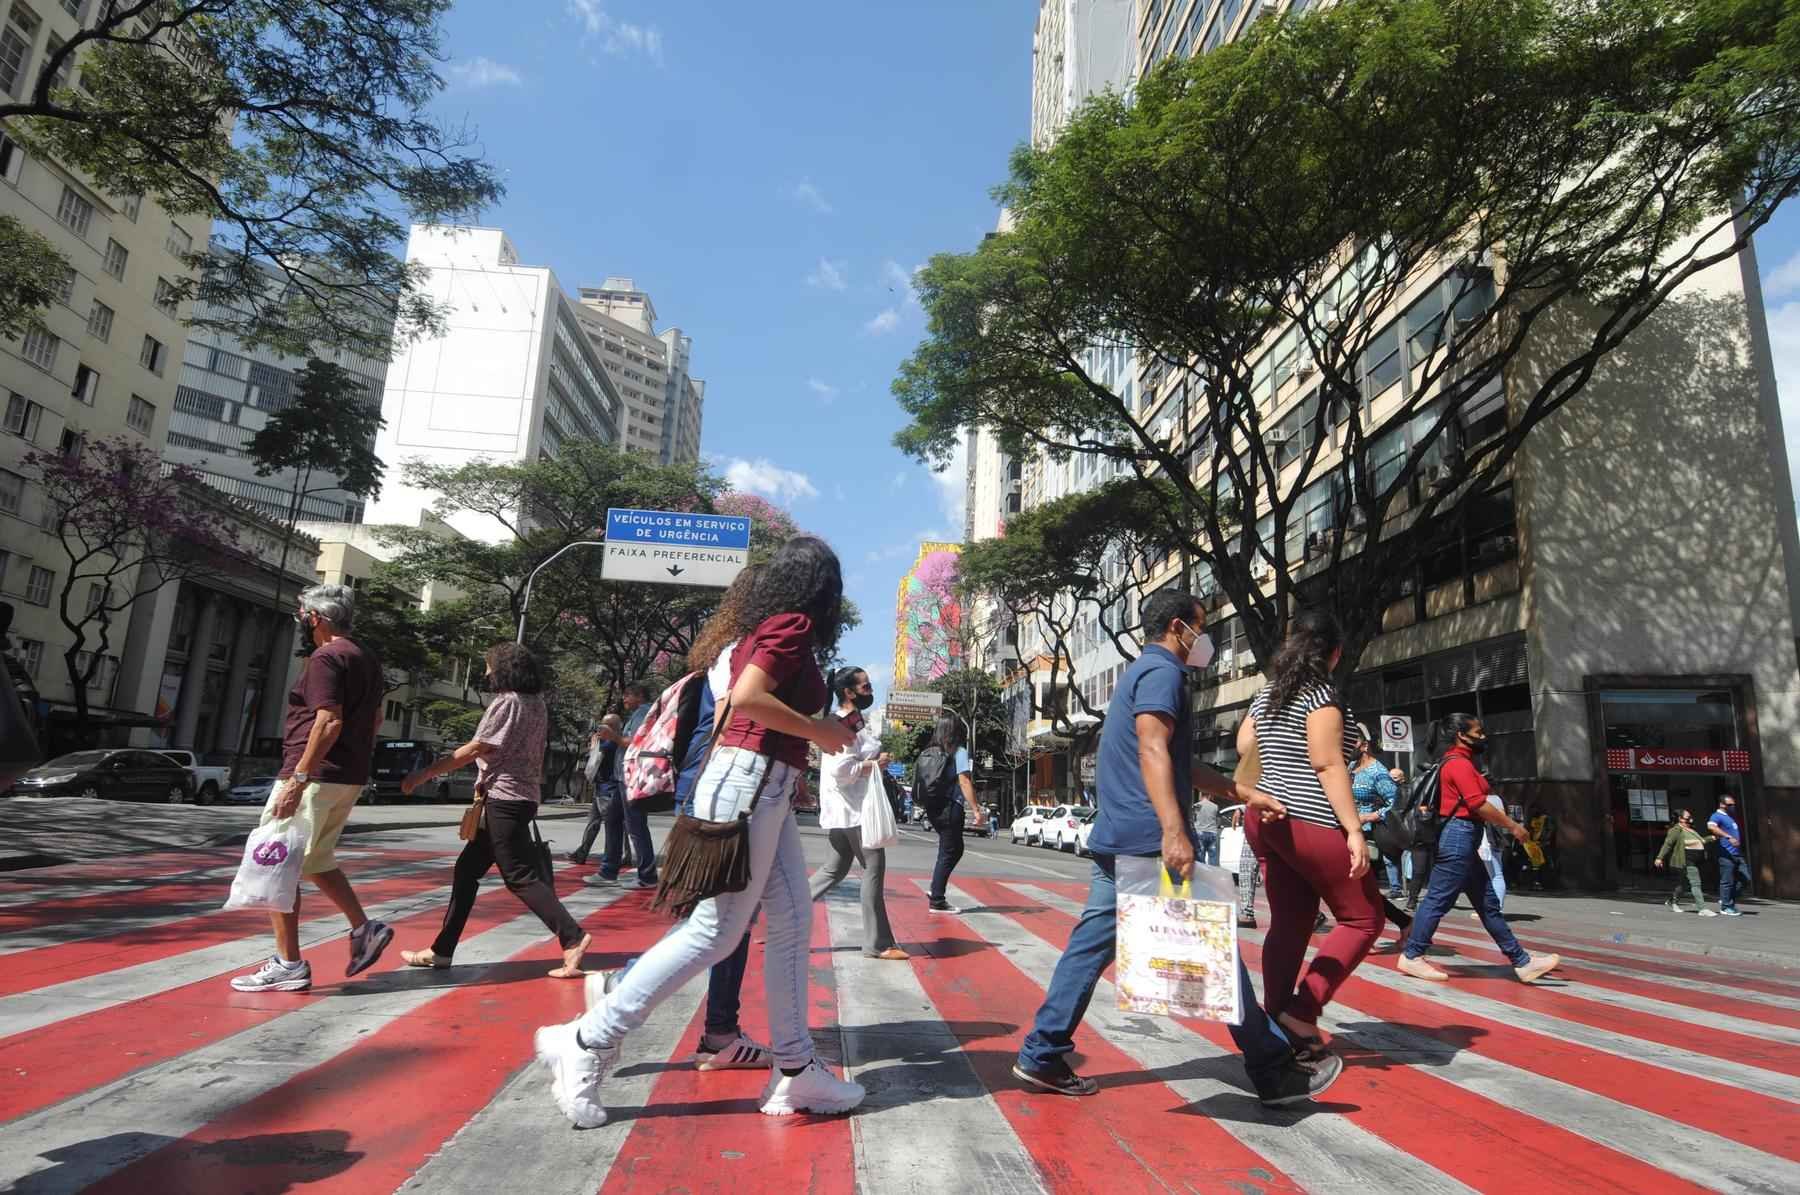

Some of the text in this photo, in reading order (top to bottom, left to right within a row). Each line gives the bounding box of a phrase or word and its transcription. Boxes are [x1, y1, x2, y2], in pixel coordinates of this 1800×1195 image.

[614, 511, 745, 532] VEÍCULOS EM SERVIÇO
[636, 528, 719, 542] DE URGÊNCIA
[610, 547, 742, 564] FAIXA PREFERENCIAL
[1391, 721, 1402, 736] E
[1657, 755, 1720, 766] Santander
